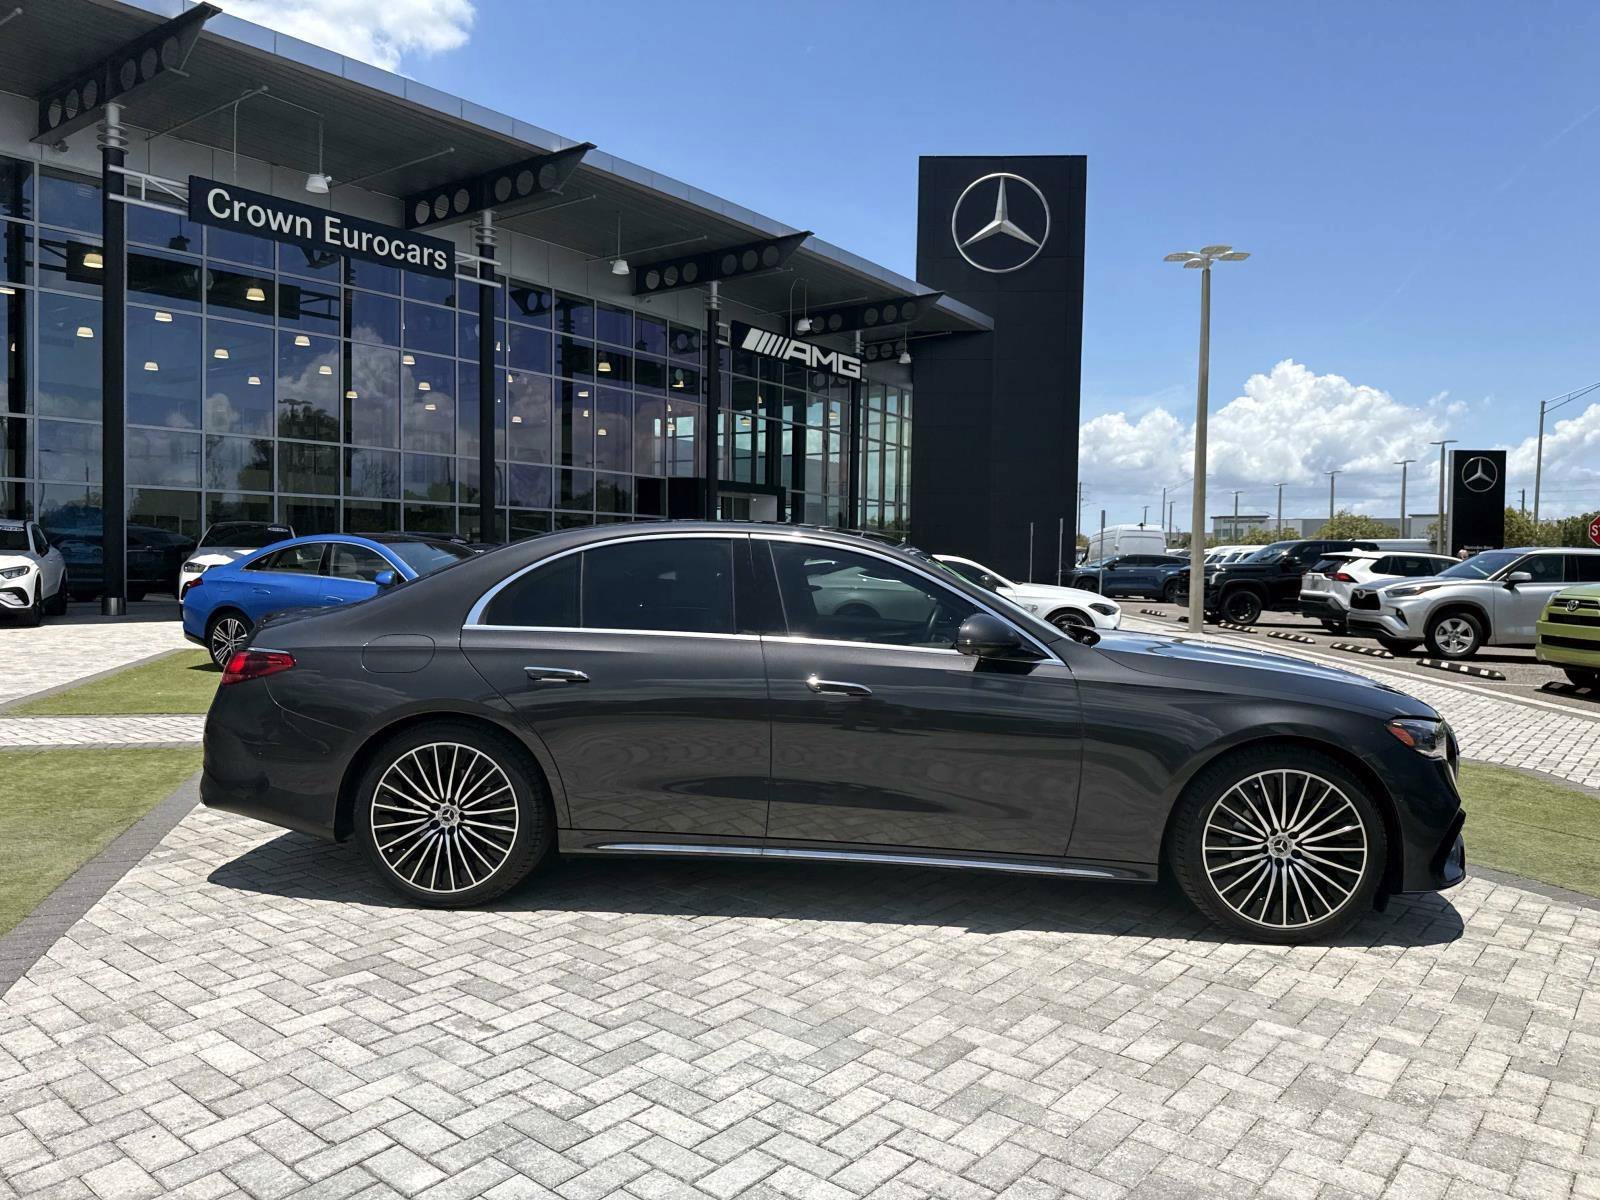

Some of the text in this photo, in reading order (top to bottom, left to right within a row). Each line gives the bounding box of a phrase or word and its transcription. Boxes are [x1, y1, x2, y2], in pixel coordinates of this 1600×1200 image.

[206, 187, 448, 271] Crown Eurocars
[782, 339, 861, 380] AMG
[1591, 524, 1600, 536] S
